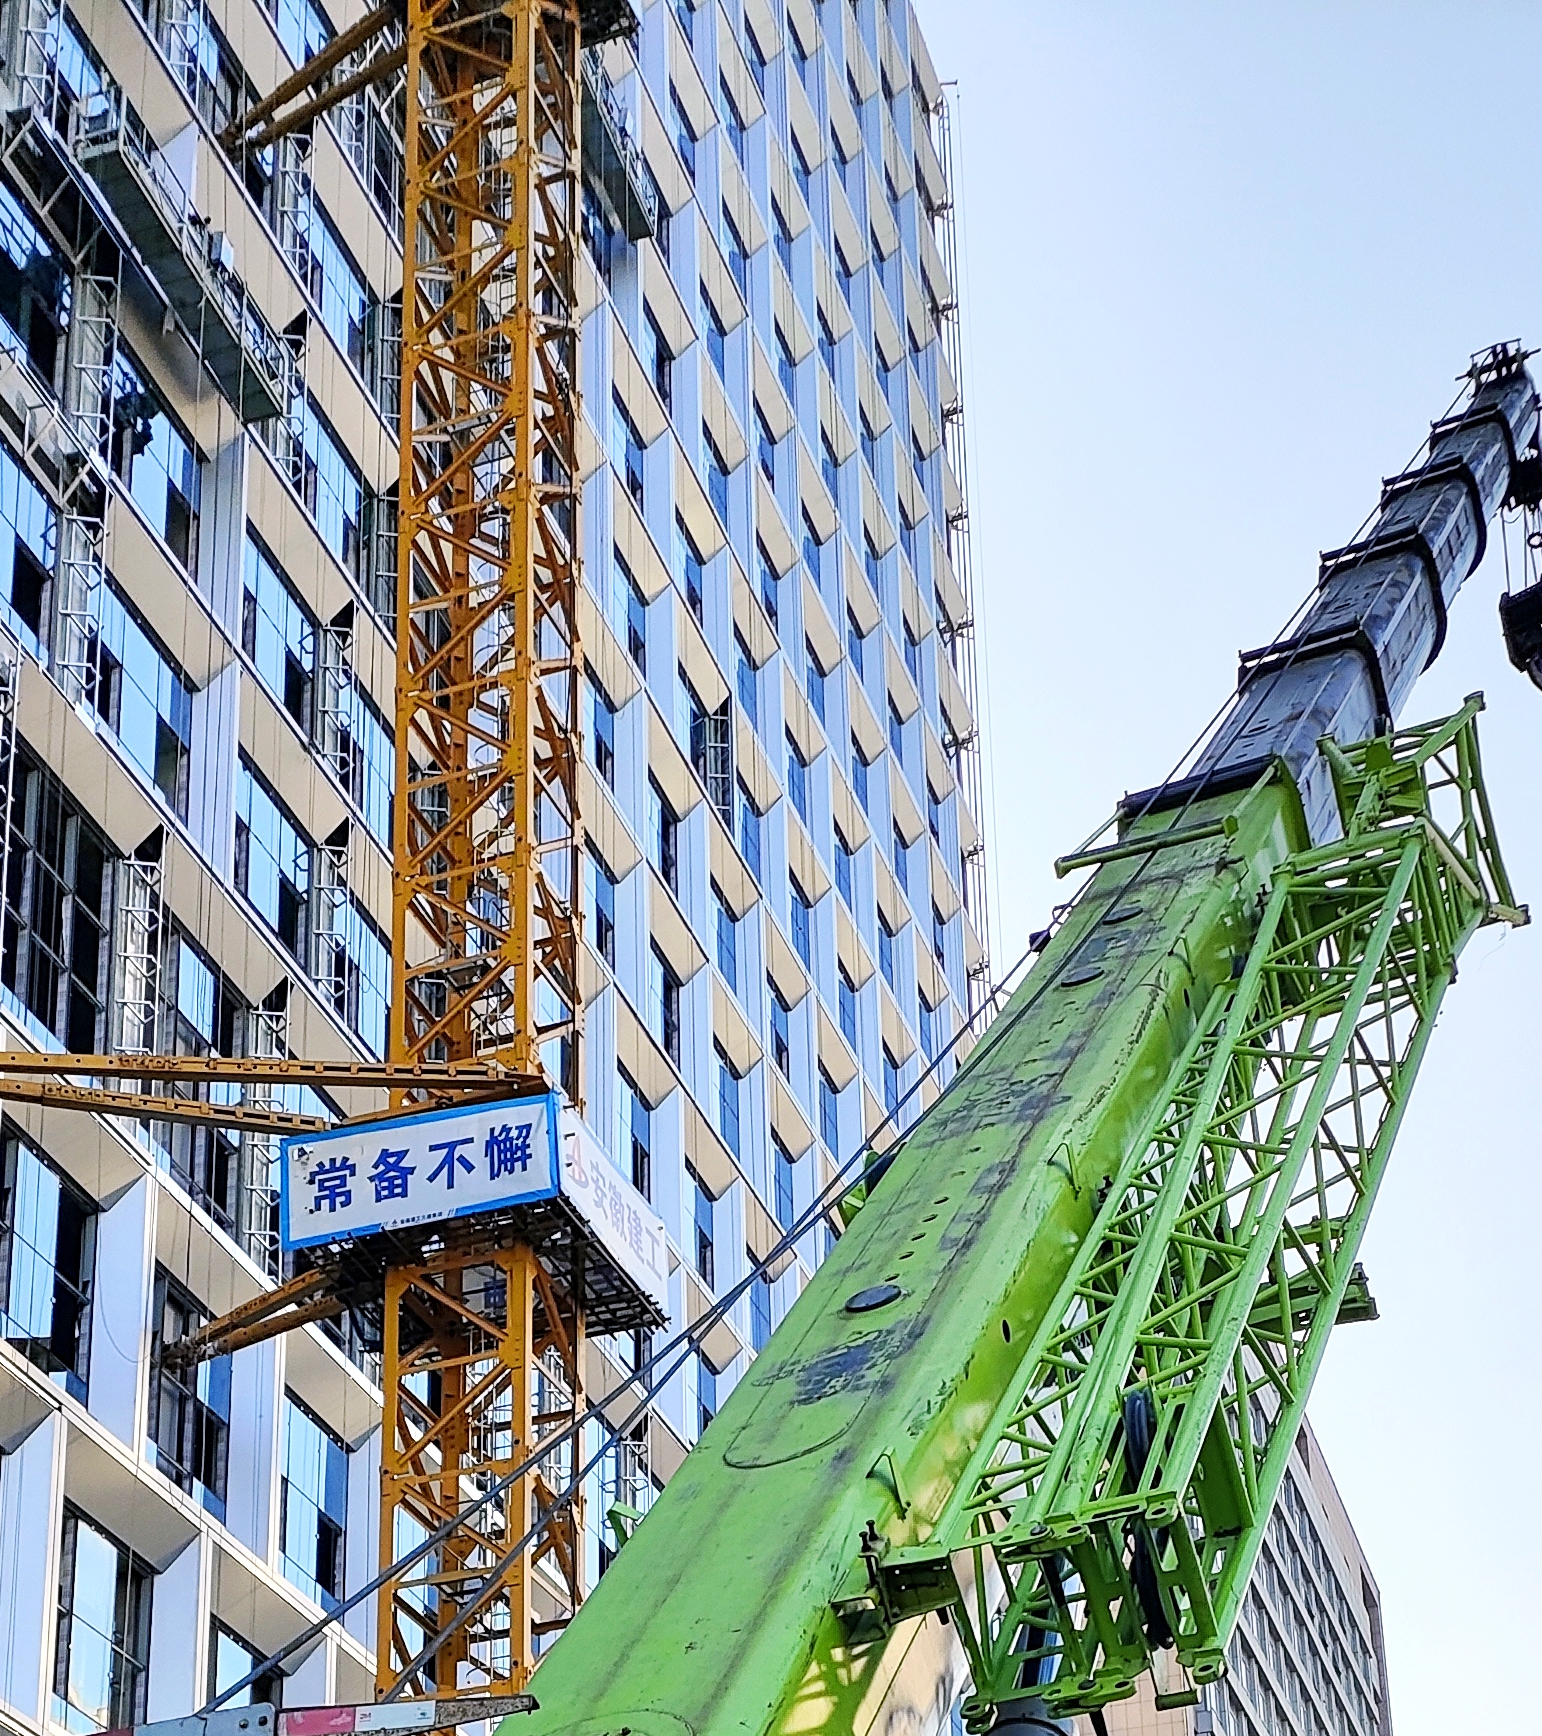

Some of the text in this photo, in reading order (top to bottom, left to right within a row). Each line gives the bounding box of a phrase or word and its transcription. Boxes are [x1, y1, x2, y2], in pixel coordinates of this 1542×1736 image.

[308, 1122, 533, 1214] 常备不懈
[590, 1159, 662, 1281] 安徽建工
